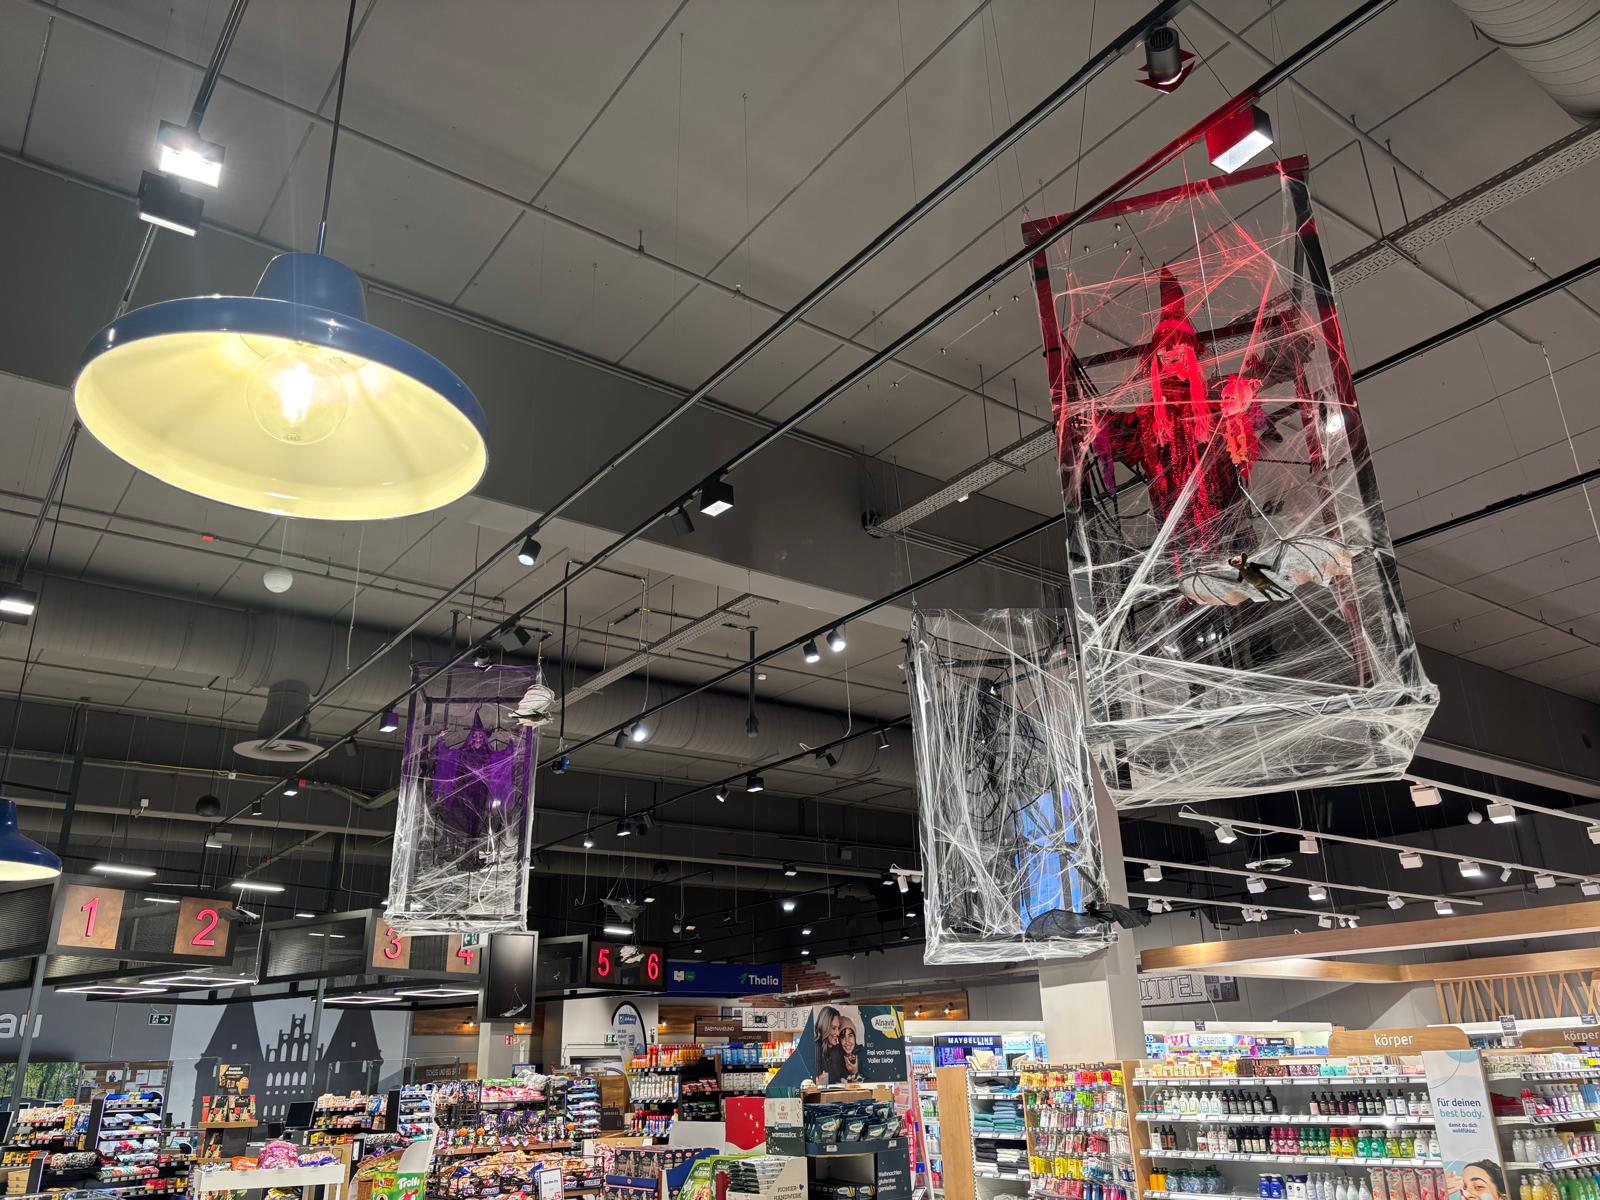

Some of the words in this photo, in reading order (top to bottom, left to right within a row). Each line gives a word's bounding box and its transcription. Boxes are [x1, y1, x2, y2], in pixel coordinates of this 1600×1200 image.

[80, 896, 100, 938] 1
[191, 907, 219, 946] 2
[384, 927, 402, 960] 3
[597, 948, 611, 976] 5
[647, 953, 659, 980] 6
[748, 974, 779, 985] Thalia
[875, 1018, 895, 1027] Alnavit
[948, 1036, 993, 1045] MAYBELLINE
[1196, 1035, 1227, 1046] essence
[1373, 1033, 1414, 1048] körper
[1563, 1030, 1599, 1042] körper
[1437, 1098, 1450, 1107] für
[1451, 1098, 1481, 1107] deinen
[1440, 1109, 1459, 1118] best
[1460, 1109, 1485, 1120] body.
[397, 1176, 420, 1190] Trolli
